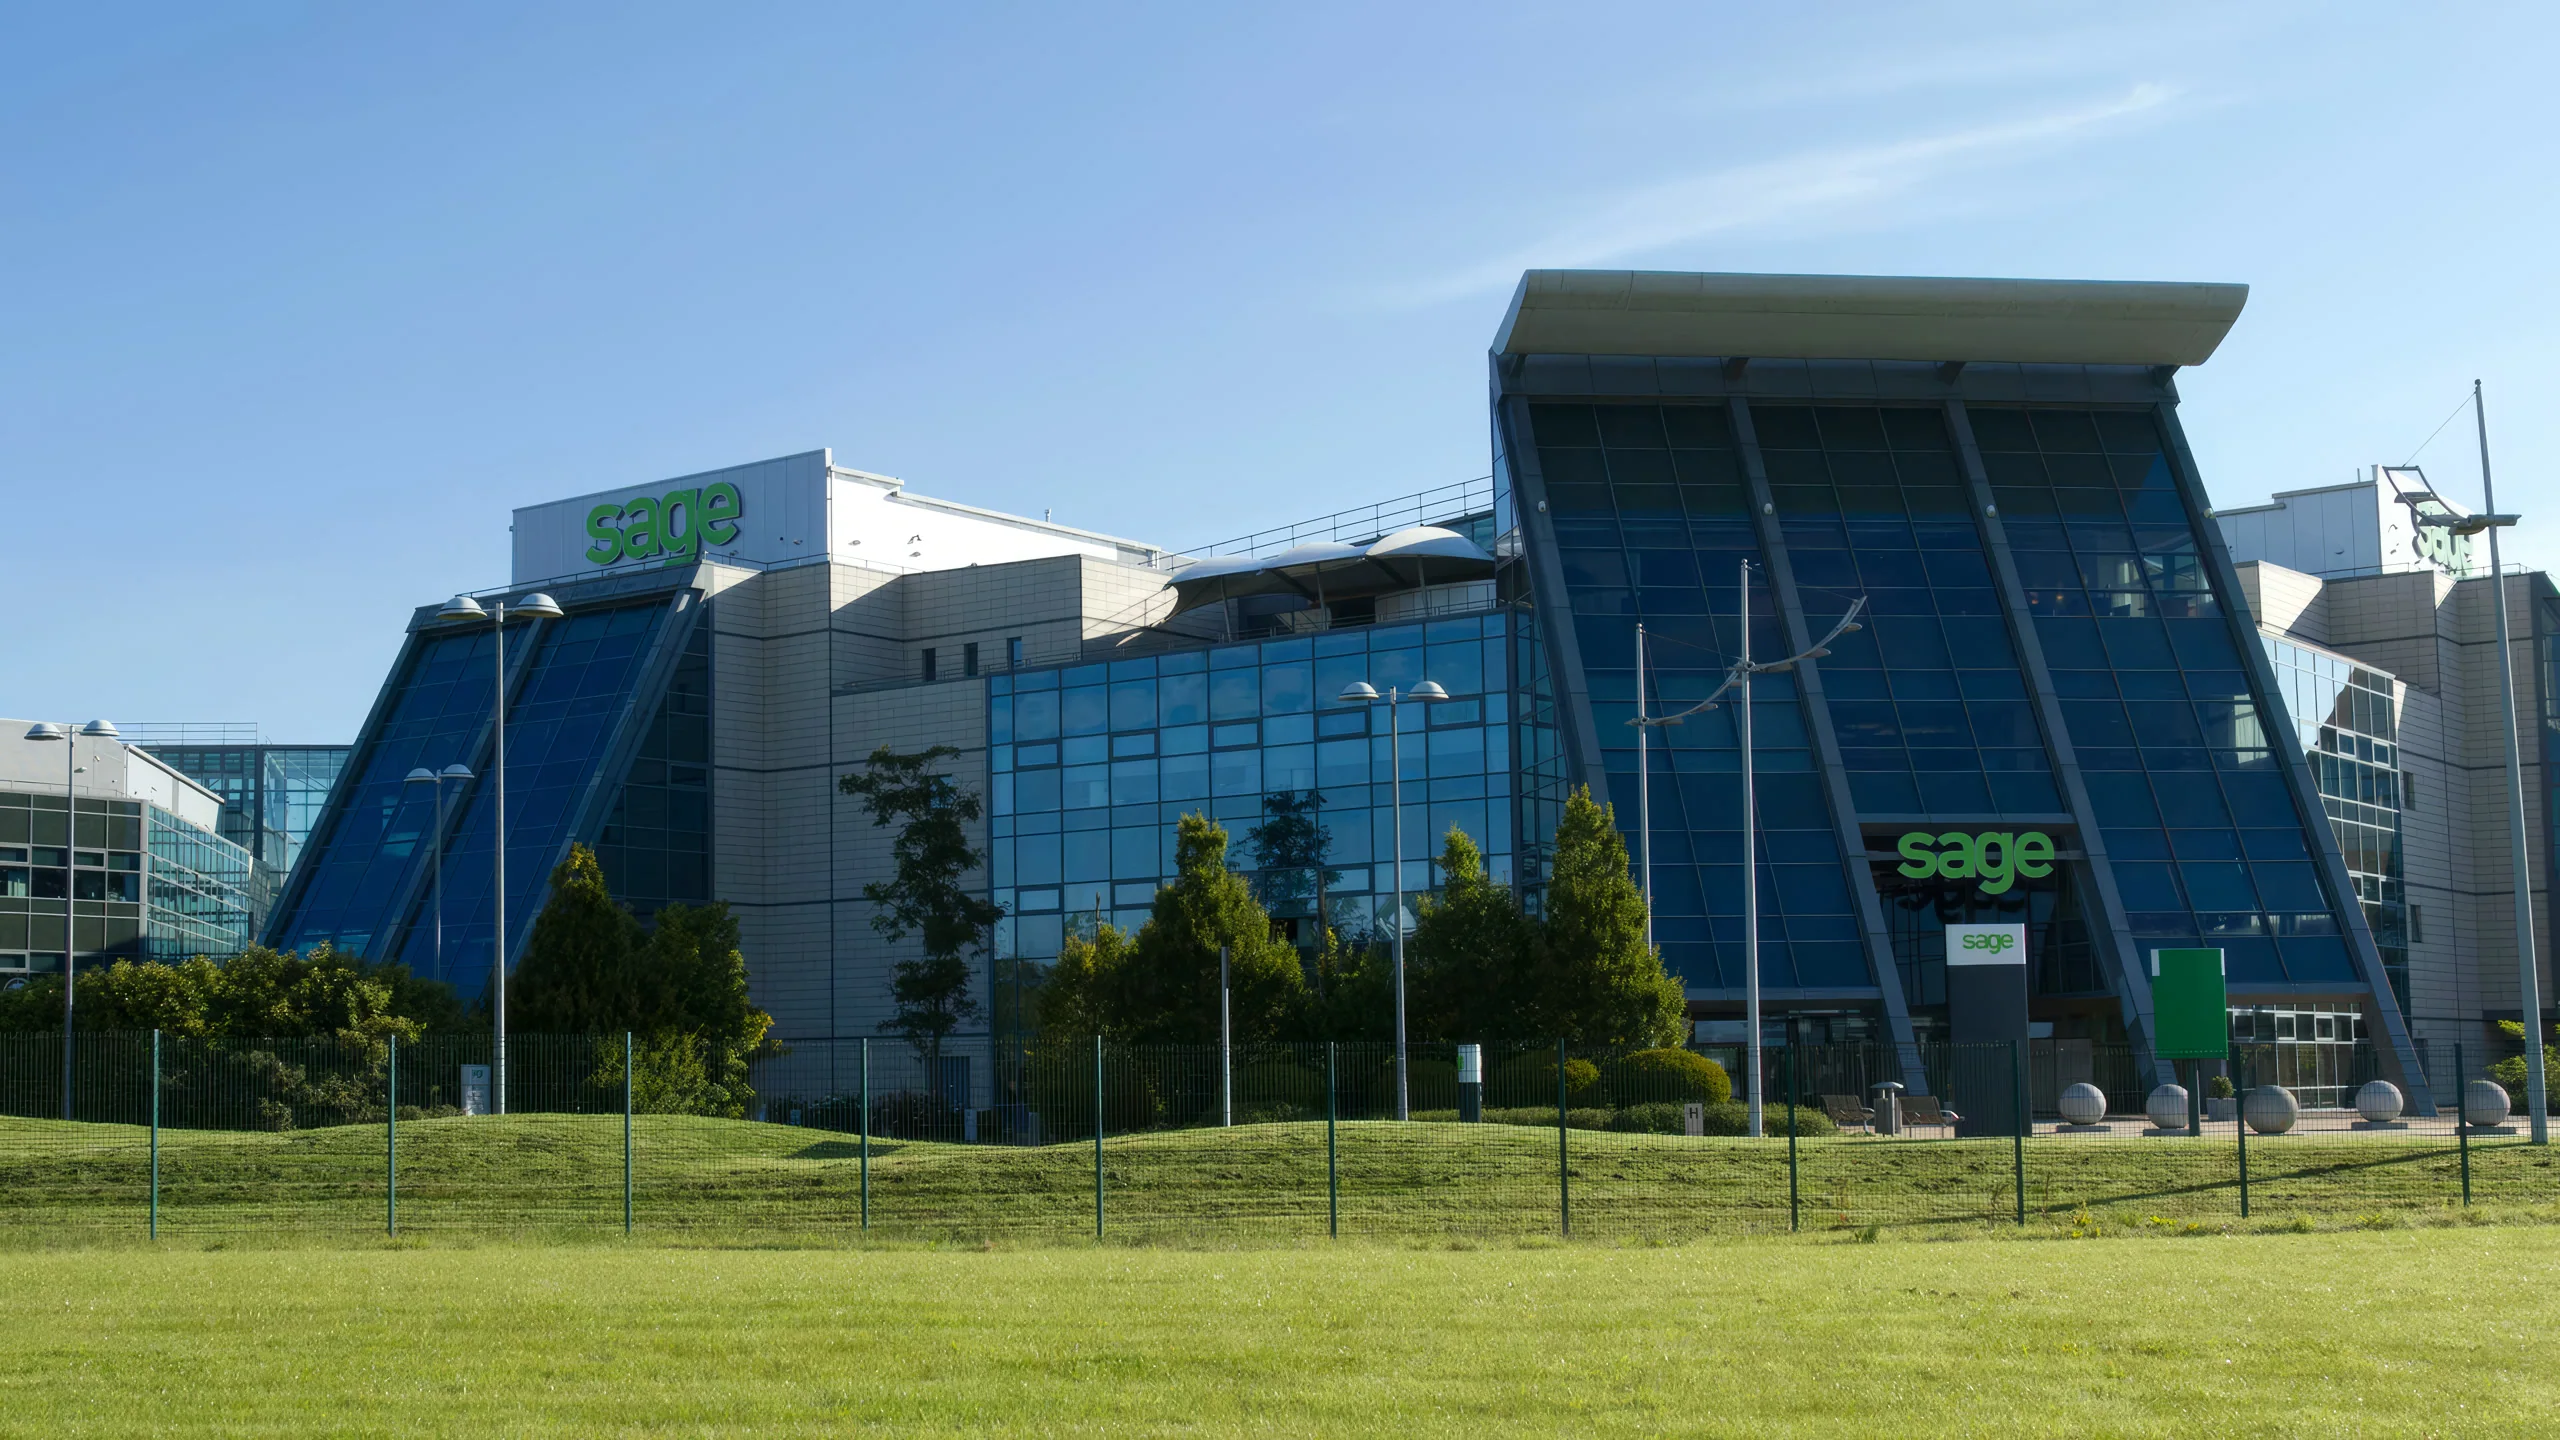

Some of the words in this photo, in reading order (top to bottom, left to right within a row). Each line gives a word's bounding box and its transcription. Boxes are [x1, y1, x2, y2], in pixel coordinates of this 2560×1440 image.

[586, 482, 742, 566] sage
[1897, 832, 2055, 895] sage
[1962, 933, 2014, 955] sage
